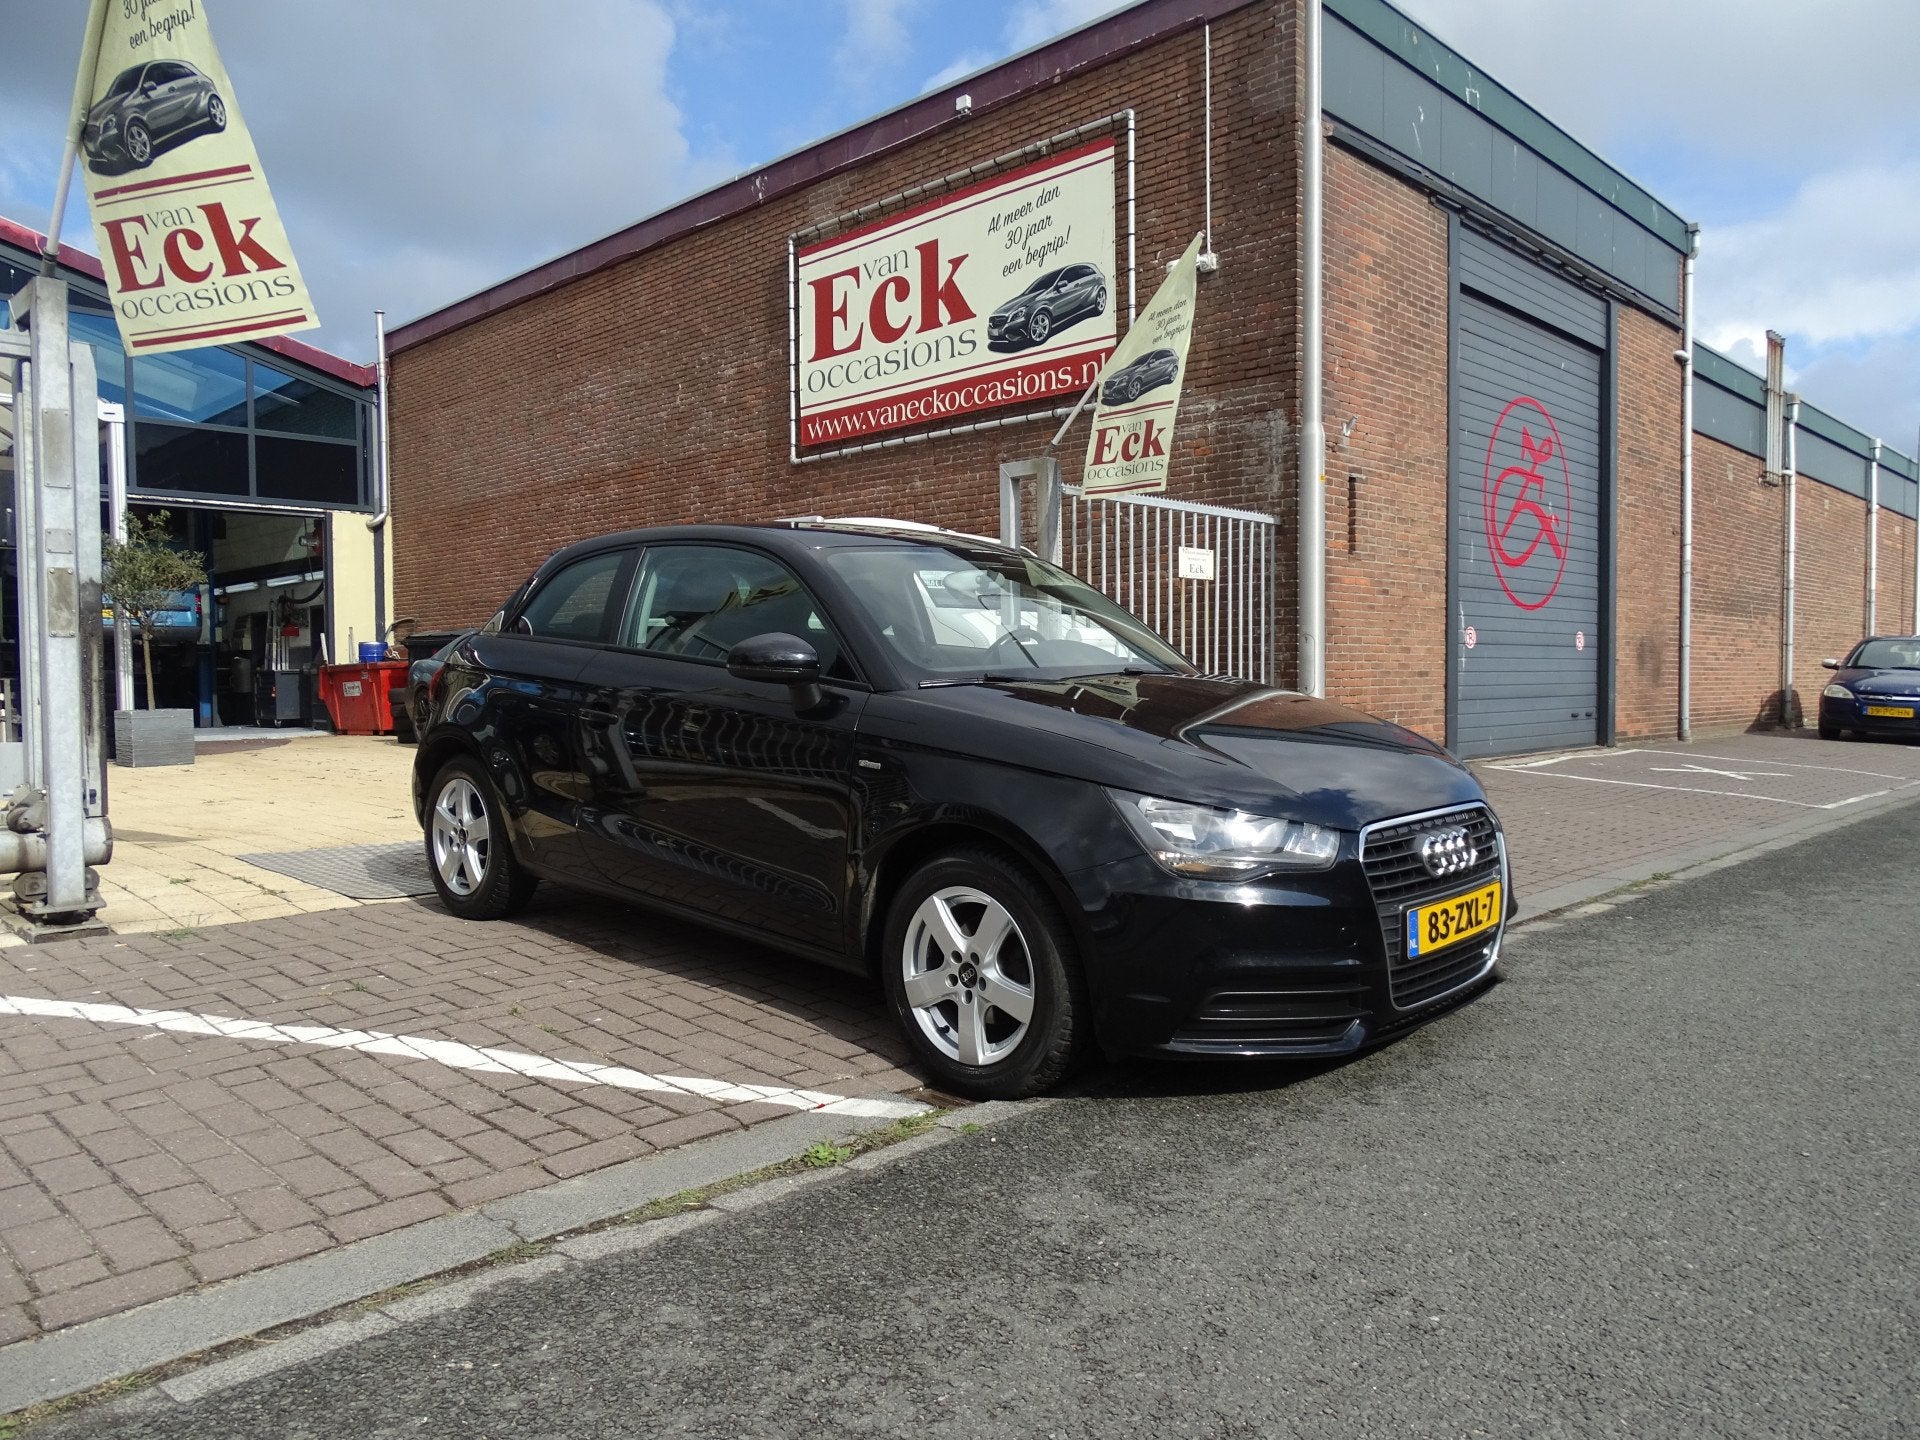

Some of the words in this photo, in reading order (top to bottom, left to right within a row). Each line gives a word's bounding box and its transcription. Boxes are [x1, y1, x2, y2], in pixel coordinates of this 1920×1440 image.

[129, 29, 149, 49] een
[148, 0, 195, 41] begrip!
[146, 206, 195, 230] van
[987, 212, 1001, 236] Al
[1003, 201, 1033, 227] meer
[1035, 185, 1061, 209] dan
[1005, 225, 1023, 250] 30
[1021, 214, 1053, 251] jaar
[101, 202, 287, 293] Eck
[863, 249, 909, 280] van
[1002, 258, 1023, 278] een
[1025, 224, 1071, 268] begrip!
[121, 274, 295, 320] occasions
[807, 238, 977, 363] Eck
[807, 328, 977, 393] occasions
[807, 352, 1107, 440] www.vaneckoccasions.nl
[1089, 418, 1167, 467] Eck
[1121, 421, 1142, 433] van
[1087, 458, 1165, 481] occasions
[1189, 563, 1205, 574] Eck
[1428, 890, 1494, 943] 83-ZXL-7
[1409, 938, 1418, 950] NL
